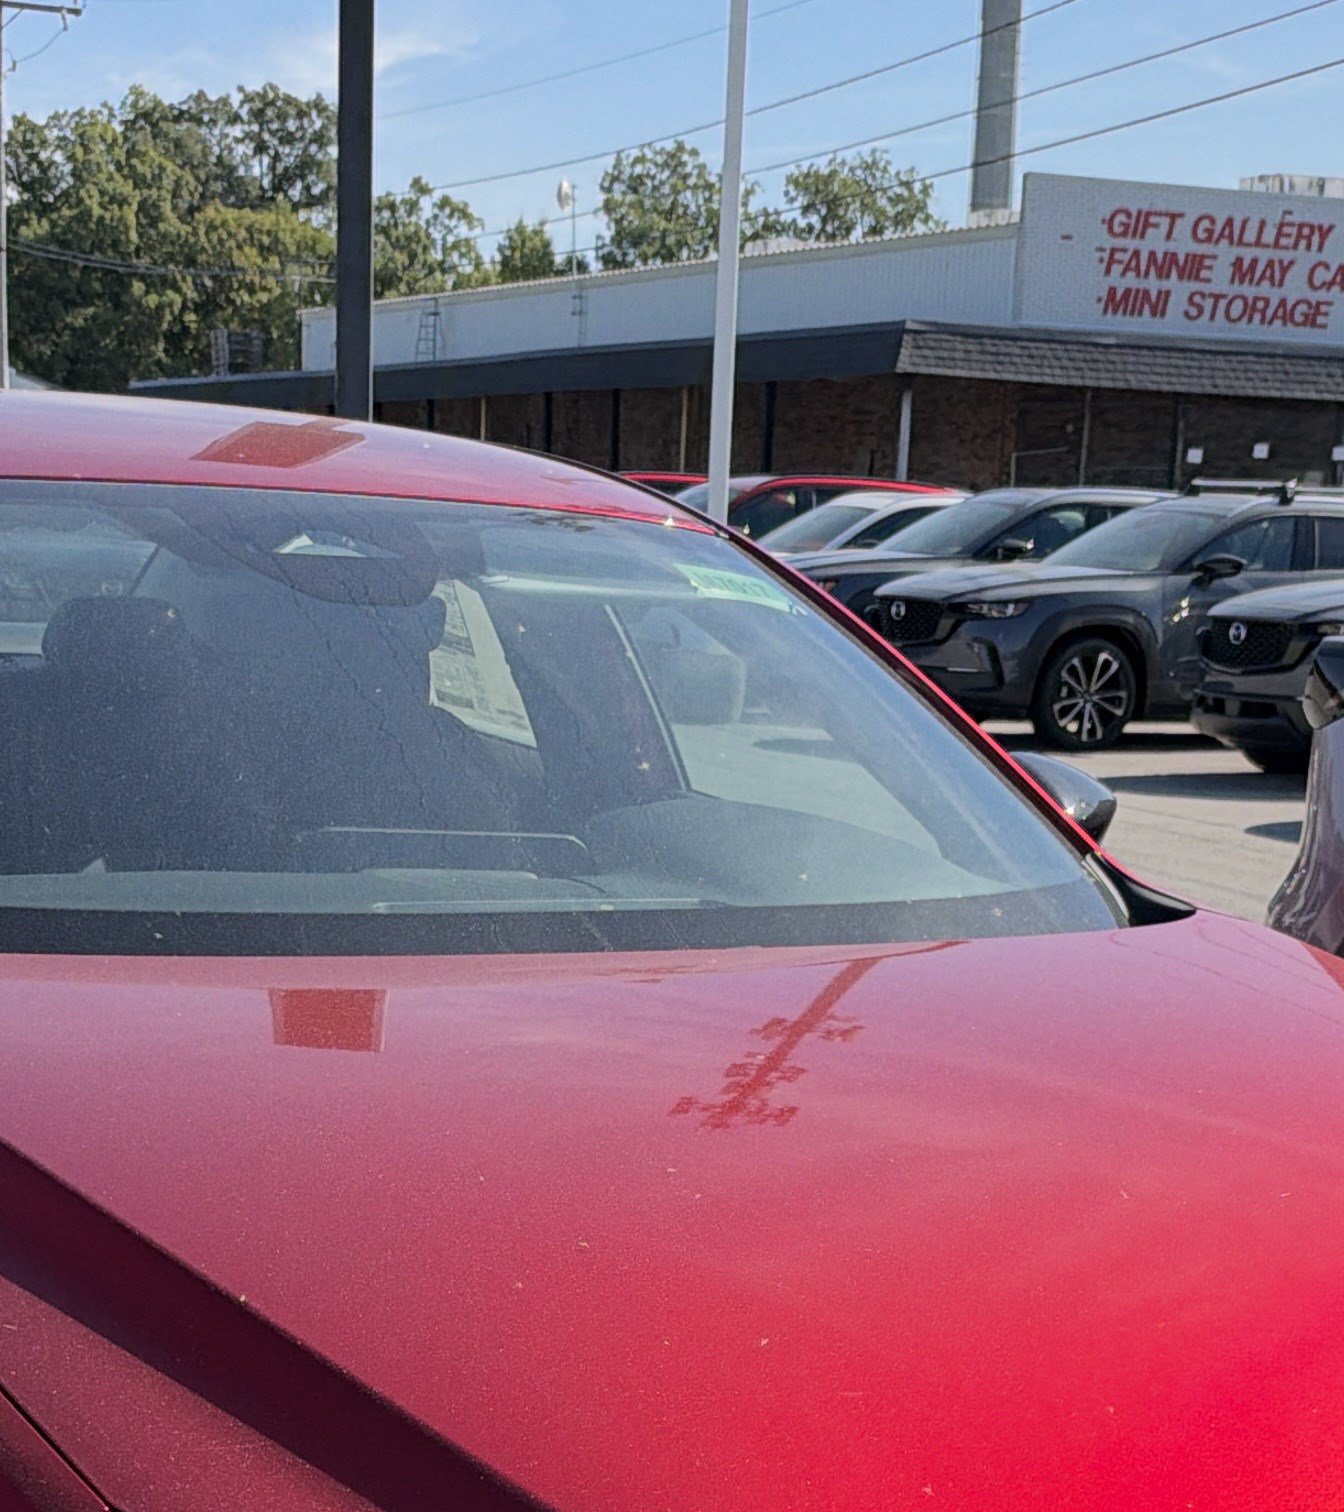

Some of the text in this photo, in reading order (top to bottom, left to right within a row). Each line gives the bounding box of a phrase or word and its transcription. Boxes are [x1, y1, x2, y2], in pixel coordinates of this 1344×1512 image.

[1106, 208, 1336, 253] GIFT GALLERY
[1103, 248, 1217, 283] FANNIE
[1230, 256, 1296, 288] MAY
[1103, 286, 1334, 329] MINI STORAGE
